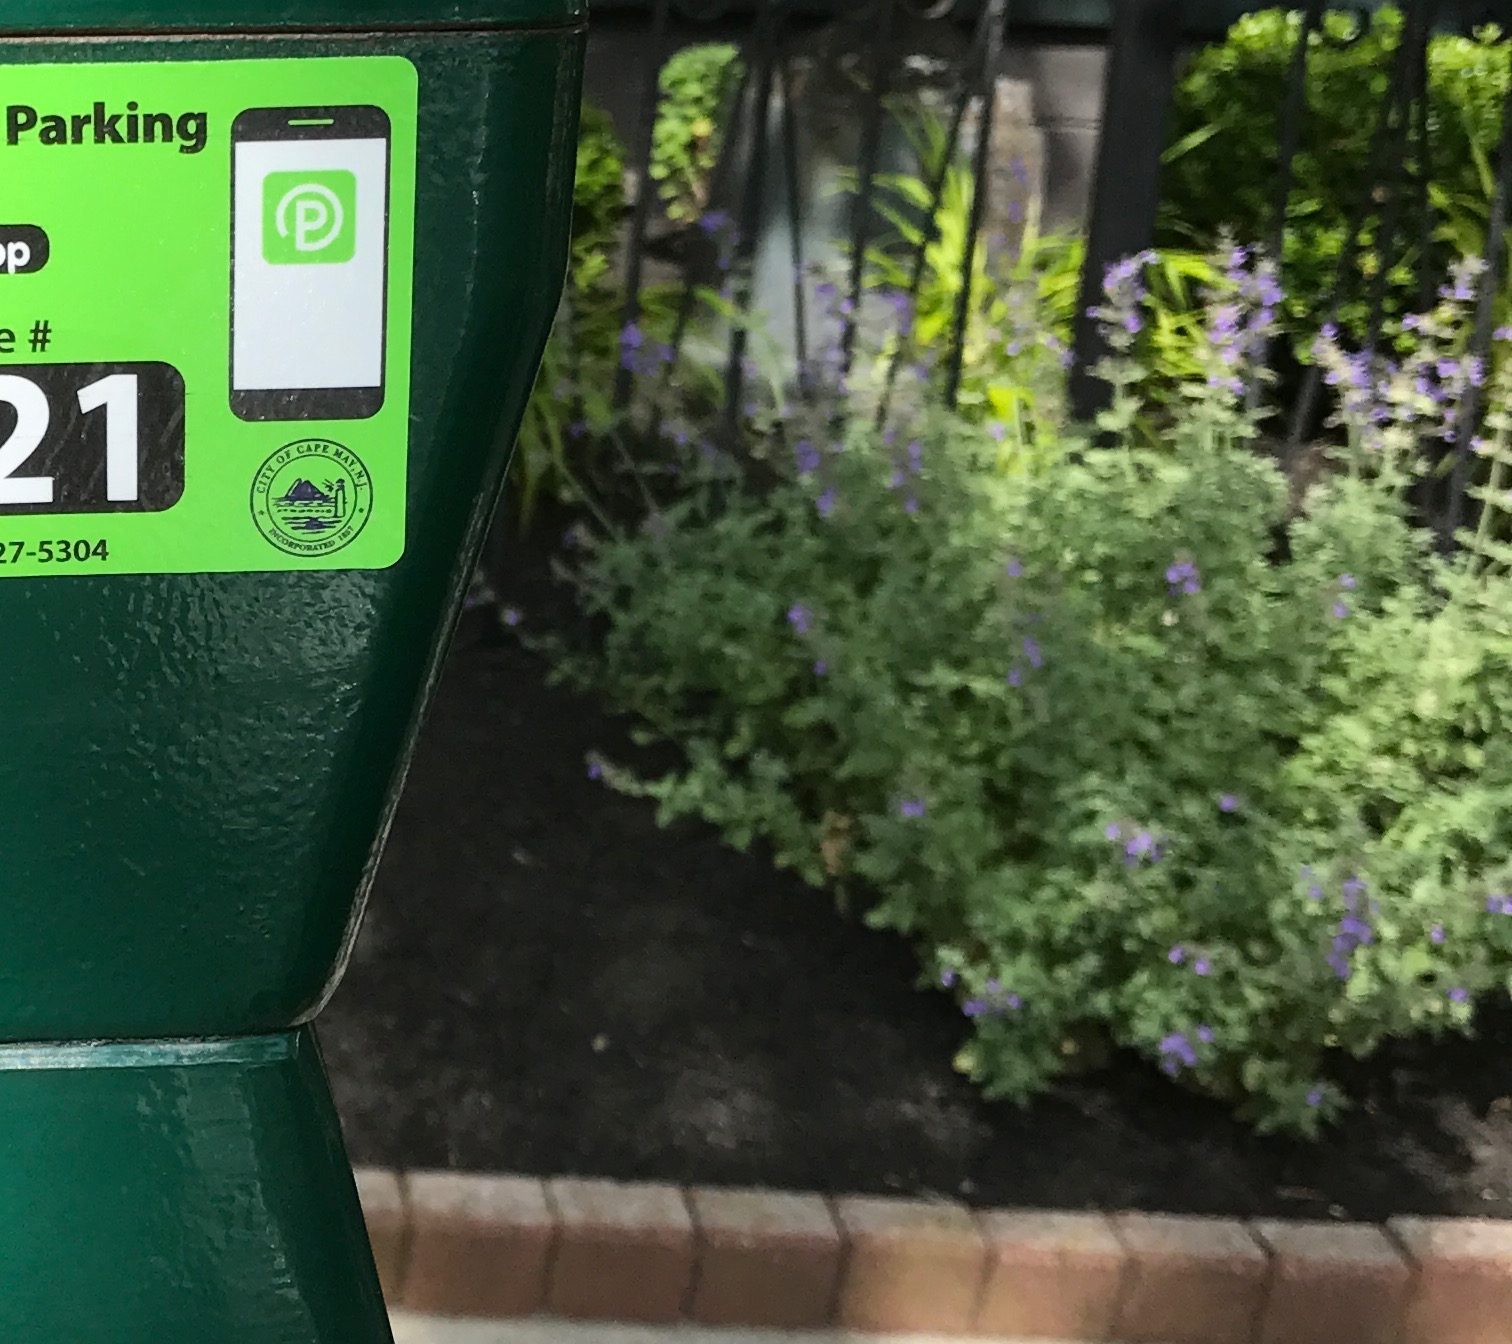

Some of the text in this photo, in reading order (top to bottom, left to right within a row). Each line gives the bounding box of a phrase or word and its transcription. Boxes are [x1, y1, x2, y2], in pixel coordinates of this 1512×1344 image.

[6, 101, 208, 155] Parking
[28, 320, 52, 354] #
[256, 464, 276, 494] CITY
[276, 450, 291, 465] OF
[296, 443, 330, 454] CAPE
[333, 449, 357, 472] MAY,
[269, 528, 336, 552] INCORPORATED
